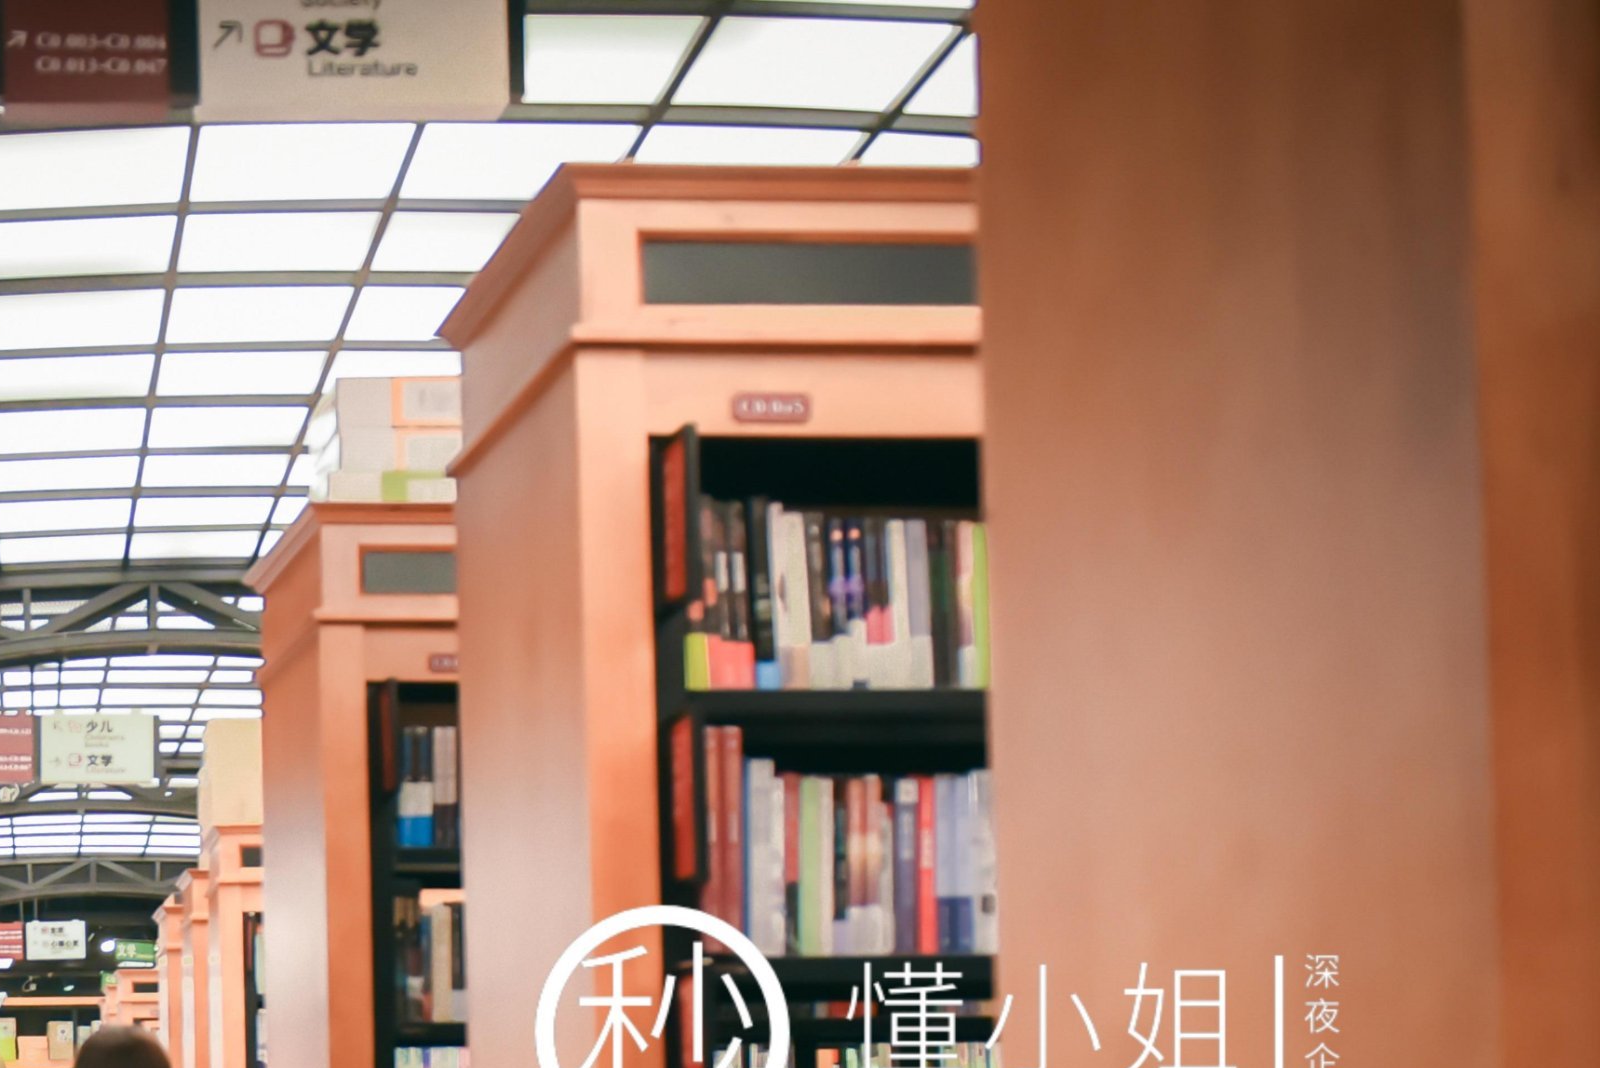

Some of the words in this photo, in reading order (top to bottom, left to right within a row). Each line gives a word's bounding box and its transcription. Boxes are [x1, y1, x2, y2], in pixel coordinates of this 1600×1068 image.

[306, 19, 380, 56] 文学
[307, 59, 418, 77] Literature
[86, 720, 113, 733] 少儿
[87, 754, 113, 767] 文学
